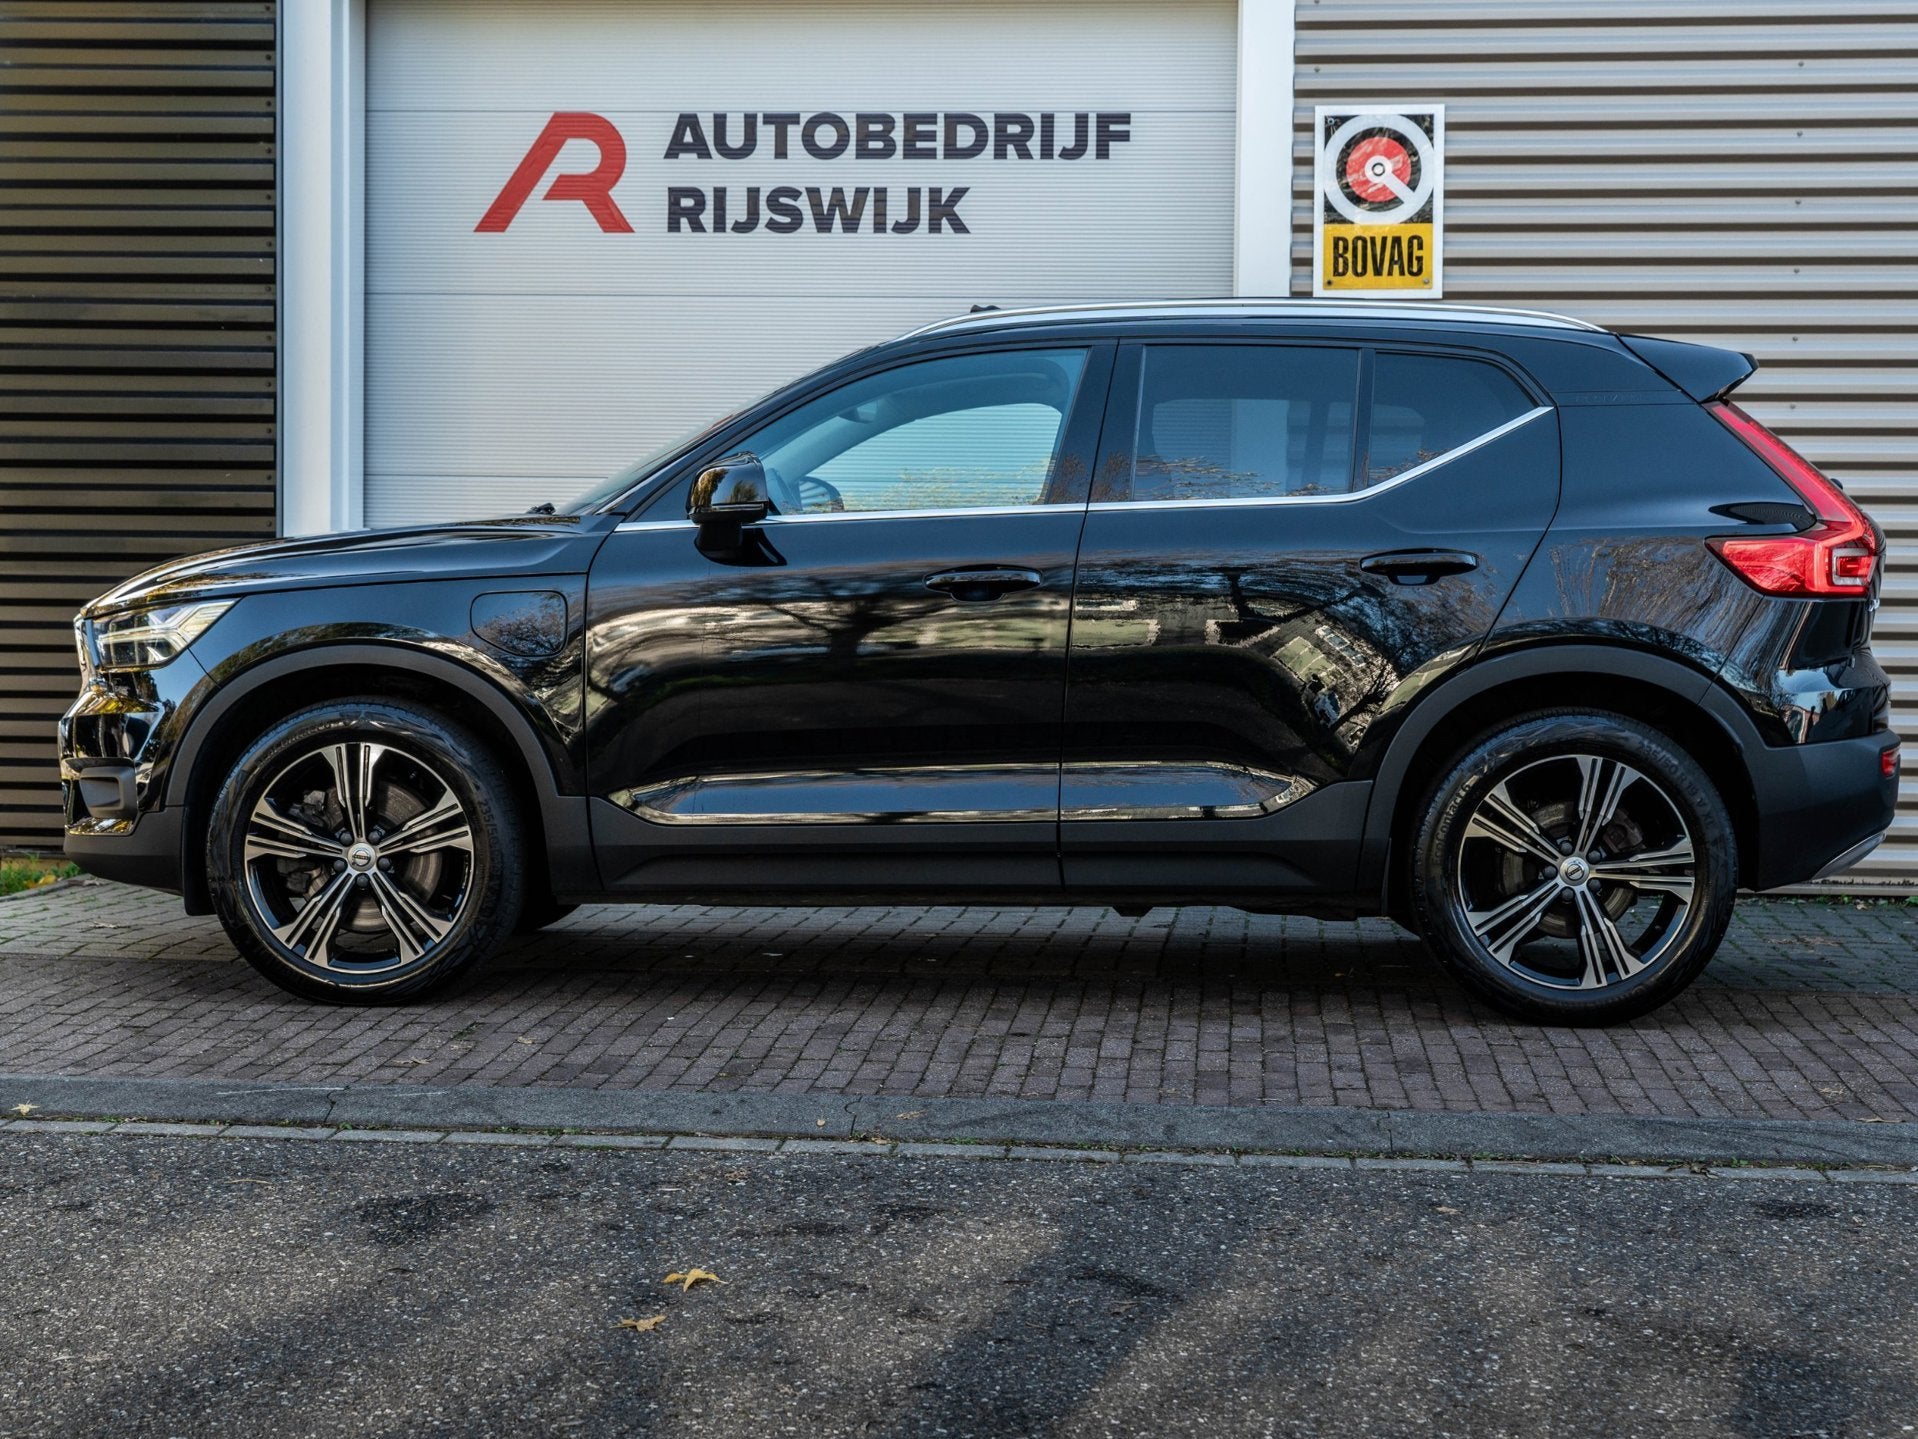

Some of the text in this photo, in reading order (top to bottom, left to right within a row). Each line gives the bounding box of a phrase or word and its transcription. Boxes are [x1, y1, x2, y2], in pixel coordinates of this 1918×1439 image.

[664, 113, 1131, 160] AUTOBEDRIJF
[667, 186, 971, 233] RIJSWIJK
[1332, 235, 1424, 277] BOVAG
